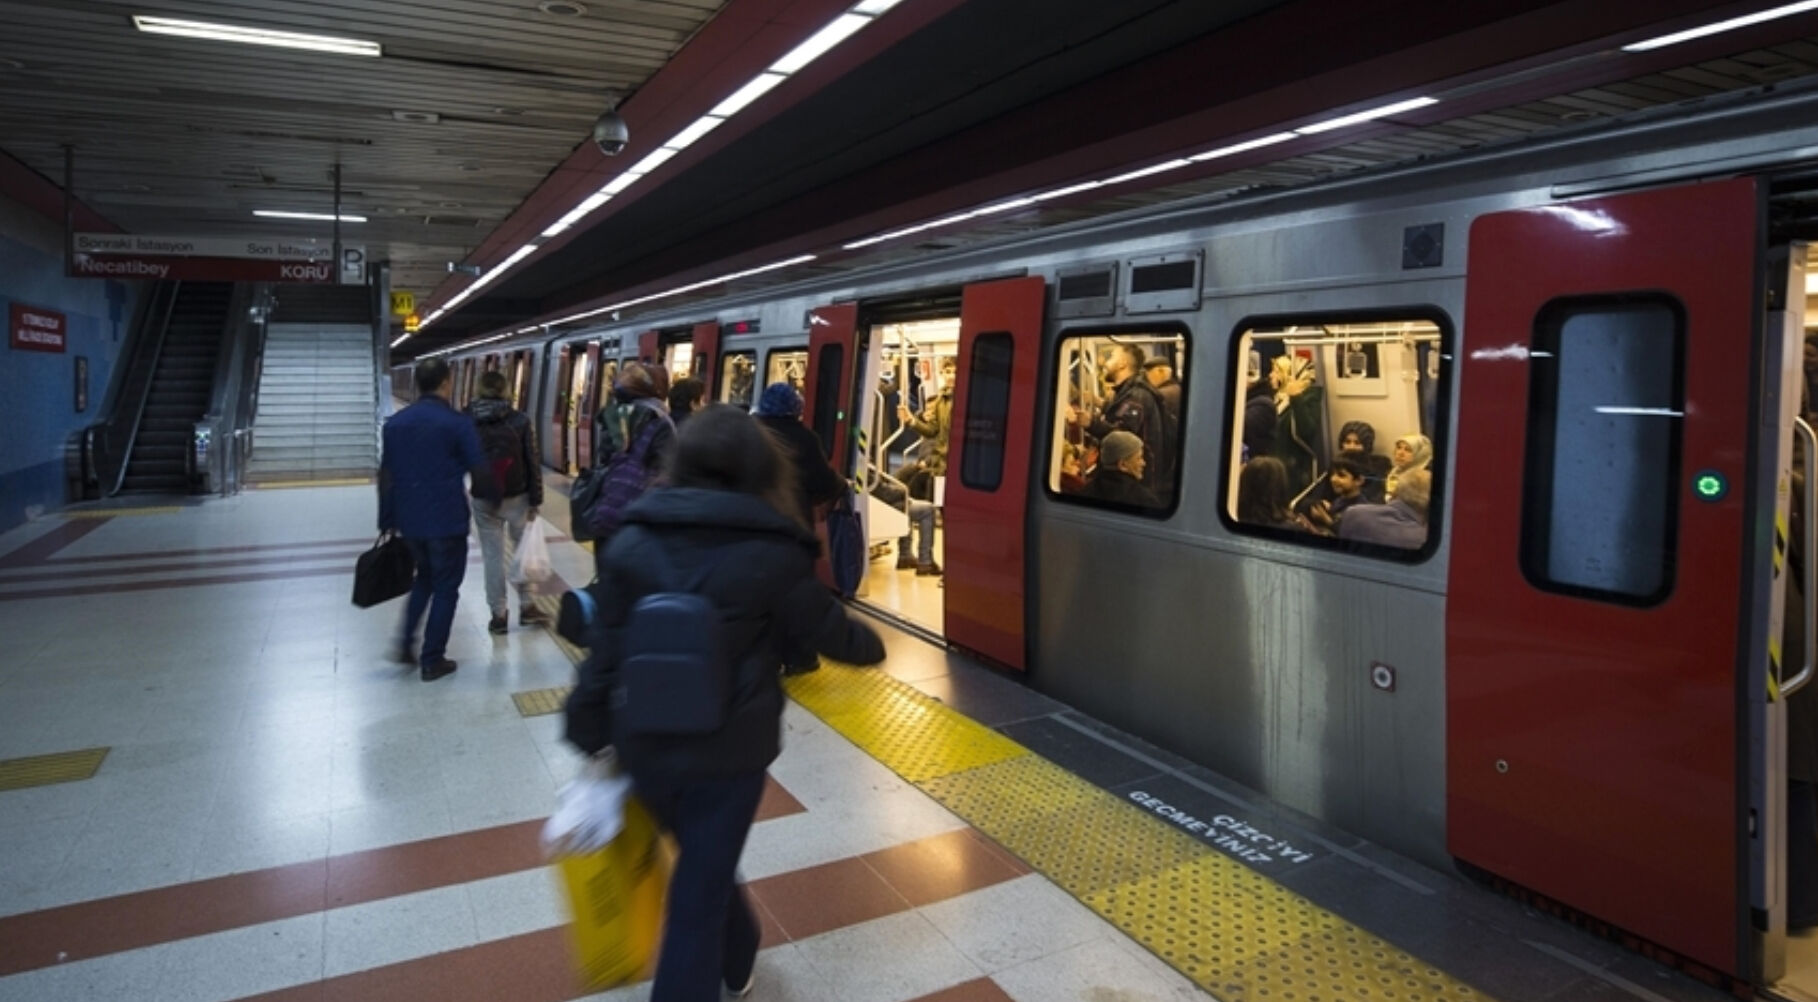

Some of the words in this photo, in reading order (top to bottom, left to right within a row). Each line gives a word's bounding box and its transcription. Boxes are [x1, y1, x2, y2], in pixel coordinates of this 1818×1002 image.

[78, 236, 132, 249] Sonraki
[247, 243, 273, 255] Son
[80, 260, 170, 278] Necatibey
